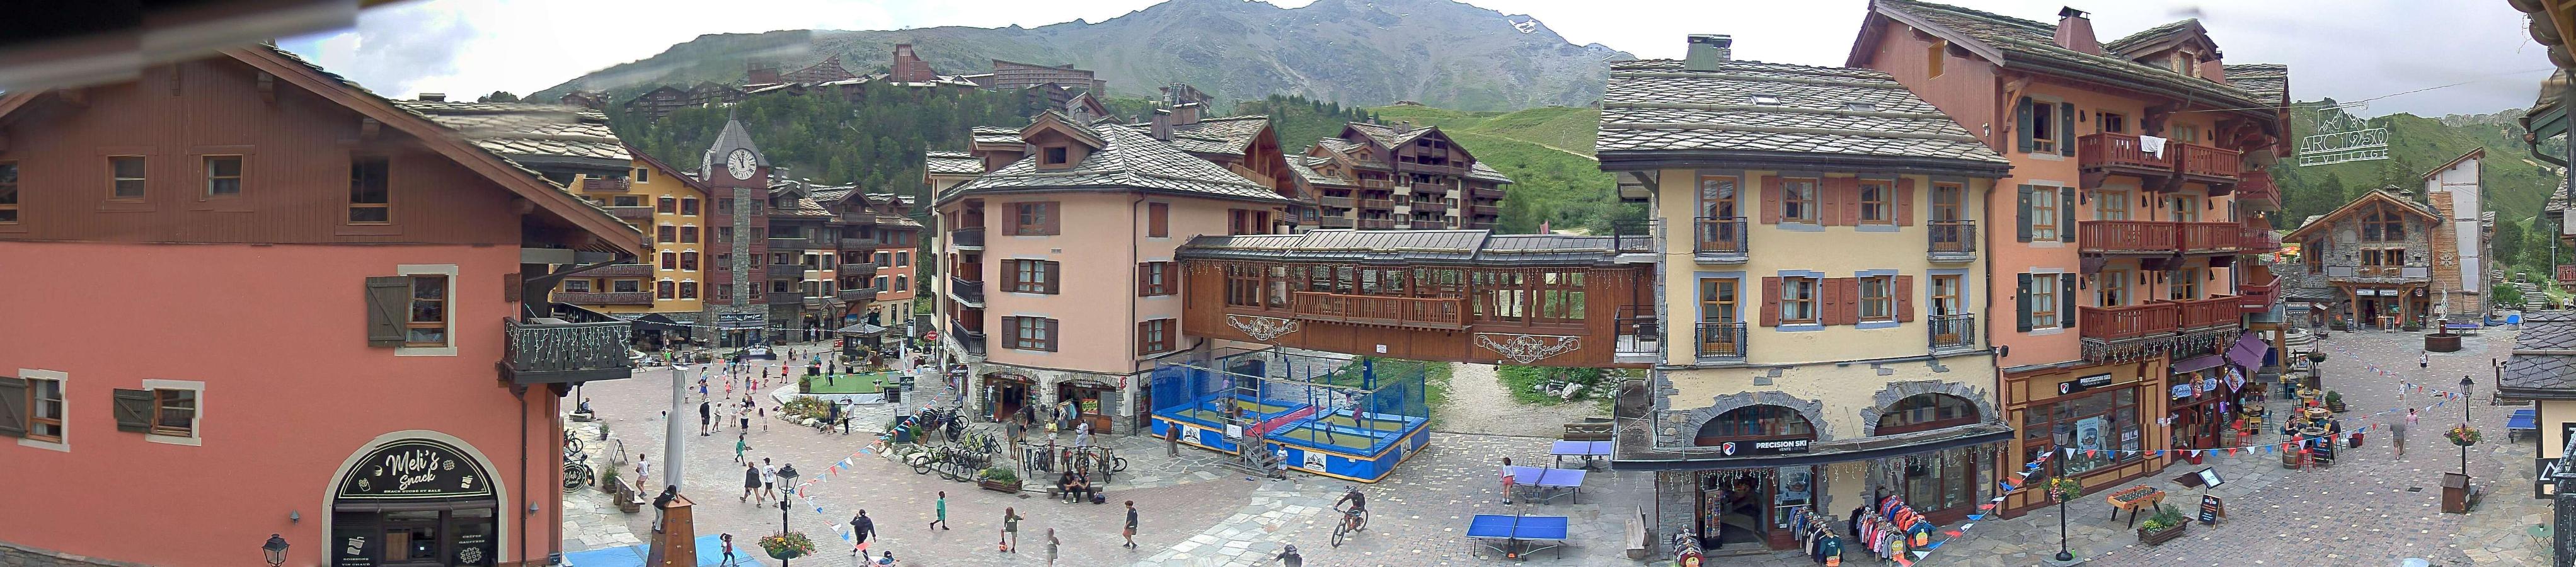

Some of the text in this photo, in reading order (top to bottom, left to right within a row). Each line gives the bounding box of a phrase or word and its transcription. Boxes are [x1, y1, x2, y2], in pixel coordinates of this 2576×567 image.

[2299, 128, 2388, 153] ARC 1950
[2299, 149, 2388, 165] LE VILLAGE
[386, 449, 440, 476] Meli's
[399, 468, 435, 490] Snack
